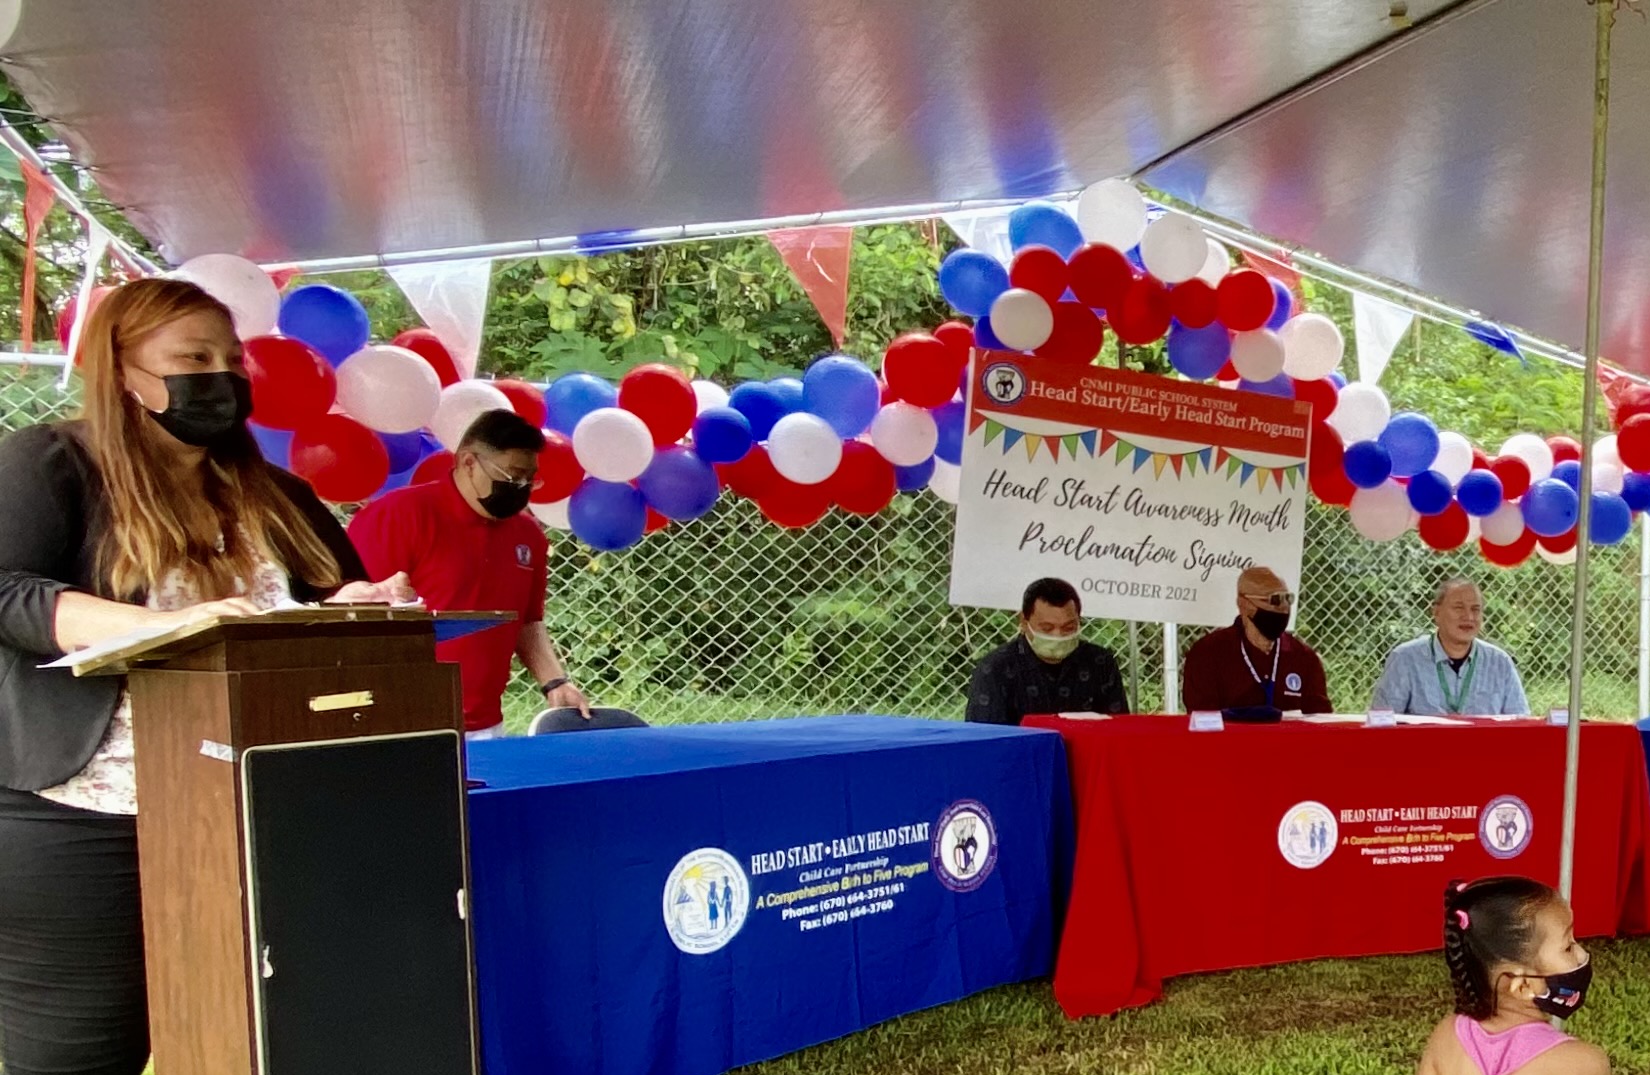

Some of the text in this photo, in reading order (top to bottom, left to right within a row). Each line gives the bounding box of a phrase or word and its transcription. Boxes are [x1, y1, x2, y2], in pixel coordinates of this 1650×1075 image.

[1080, 376, 1239, 412] CNMI PUBLIC SCHOOL SYSTEM
[1030, 380, 1077, 402] Head
[1080, 389, 1172, 422] Start/Early
[1174, 405, 1213, 426] Head
[1214, 410, 1248, 430] Start
[1249, 416, 1306, 440] Program
[982, 469, 1292, 532] Head Start Awareness Month
[1018, 521, 1178, 566] Proclamation
[1080, 577, 1199, 602] OCTOBER 2021
[1340, 805, 1478, 823] HEAD START EARLY HEAD START
[1374, 825, 1392, 833] Child
[751, 822, 930, 875] HEAD START EARLY HEAD START
[755, 895, 765, 910] A
[766, 880, 840, 907] Comprehensive
[862, 871, 872, 885] to
[874, 867, 892, 883] Five
[894, 861, 929, 880] Program
[799, 868, 822, 883] Child
[824, 866, 843, 880] Care
[782, 902, 818, 921] Phone:
[820, 894, 846, 913] (670)
[800, 916, 821, 931] Fax:
[822, 910, 848, 927] (670)
